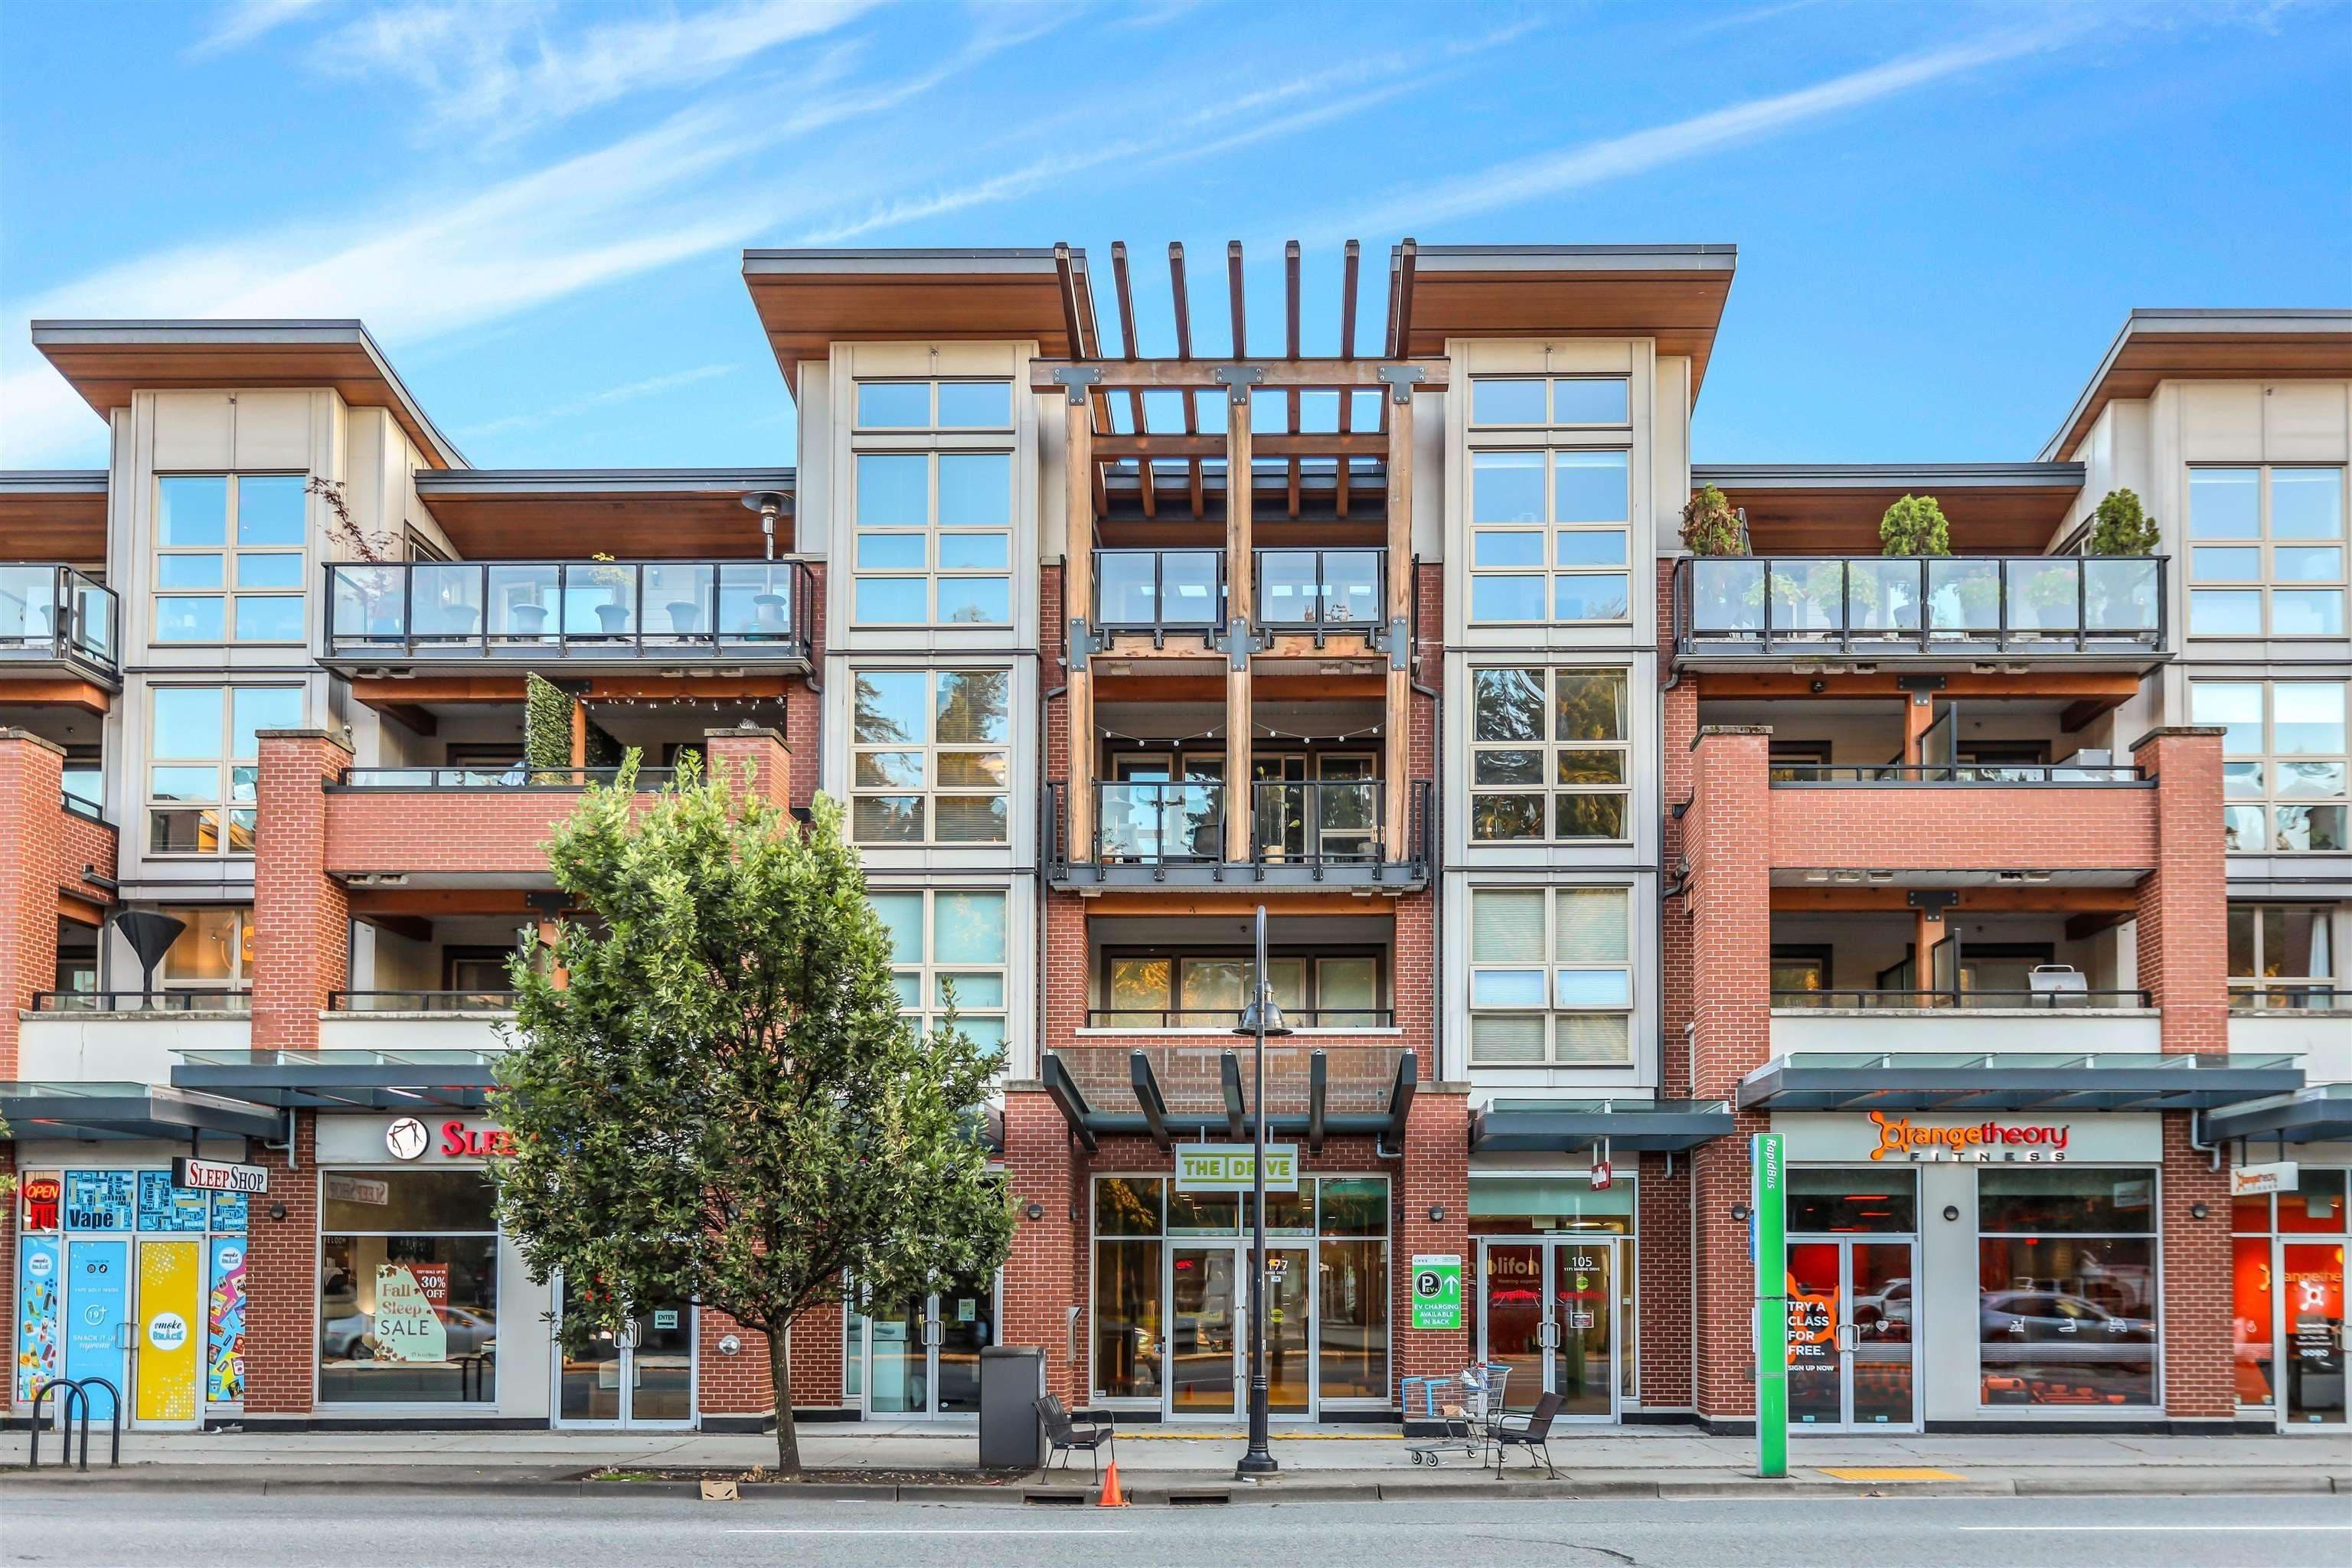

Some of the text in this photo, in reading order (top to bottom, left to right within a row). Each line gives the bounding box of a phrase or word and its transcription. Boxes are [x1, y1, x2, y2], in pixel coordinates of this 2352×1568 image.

[1910, 1152, 2065, 1161] FITNESS
[1184, 1161, 1289, 1175] THE DRVE
[1764, 1139, 1776, 1188] RapidBus
[27, 1185, 59, 1198] OPEN
[69, 1210, 114, 1229] Vape
[1572, 1256, 1592, 1267] 105
[421, 1276, 446, 1288] 30%
[1422, 1276, 1434, 1292] P
[383, 1284, 410, 1297] Fall
[426, 1289, 445, 1298] OFF
[382, 1302, 421, 1318] Sleep
[1788, 1302, 1825, 1312] TRY A
[155, 1320, 181, 1329] smoke
[1788, 1316, 1829, 1326] CLASS
[381, 1320, 429, 1335] SALE
[1788, 1331, 1815, 1341] FOR
[1788, 1345, 1825, 1355] FREE.
